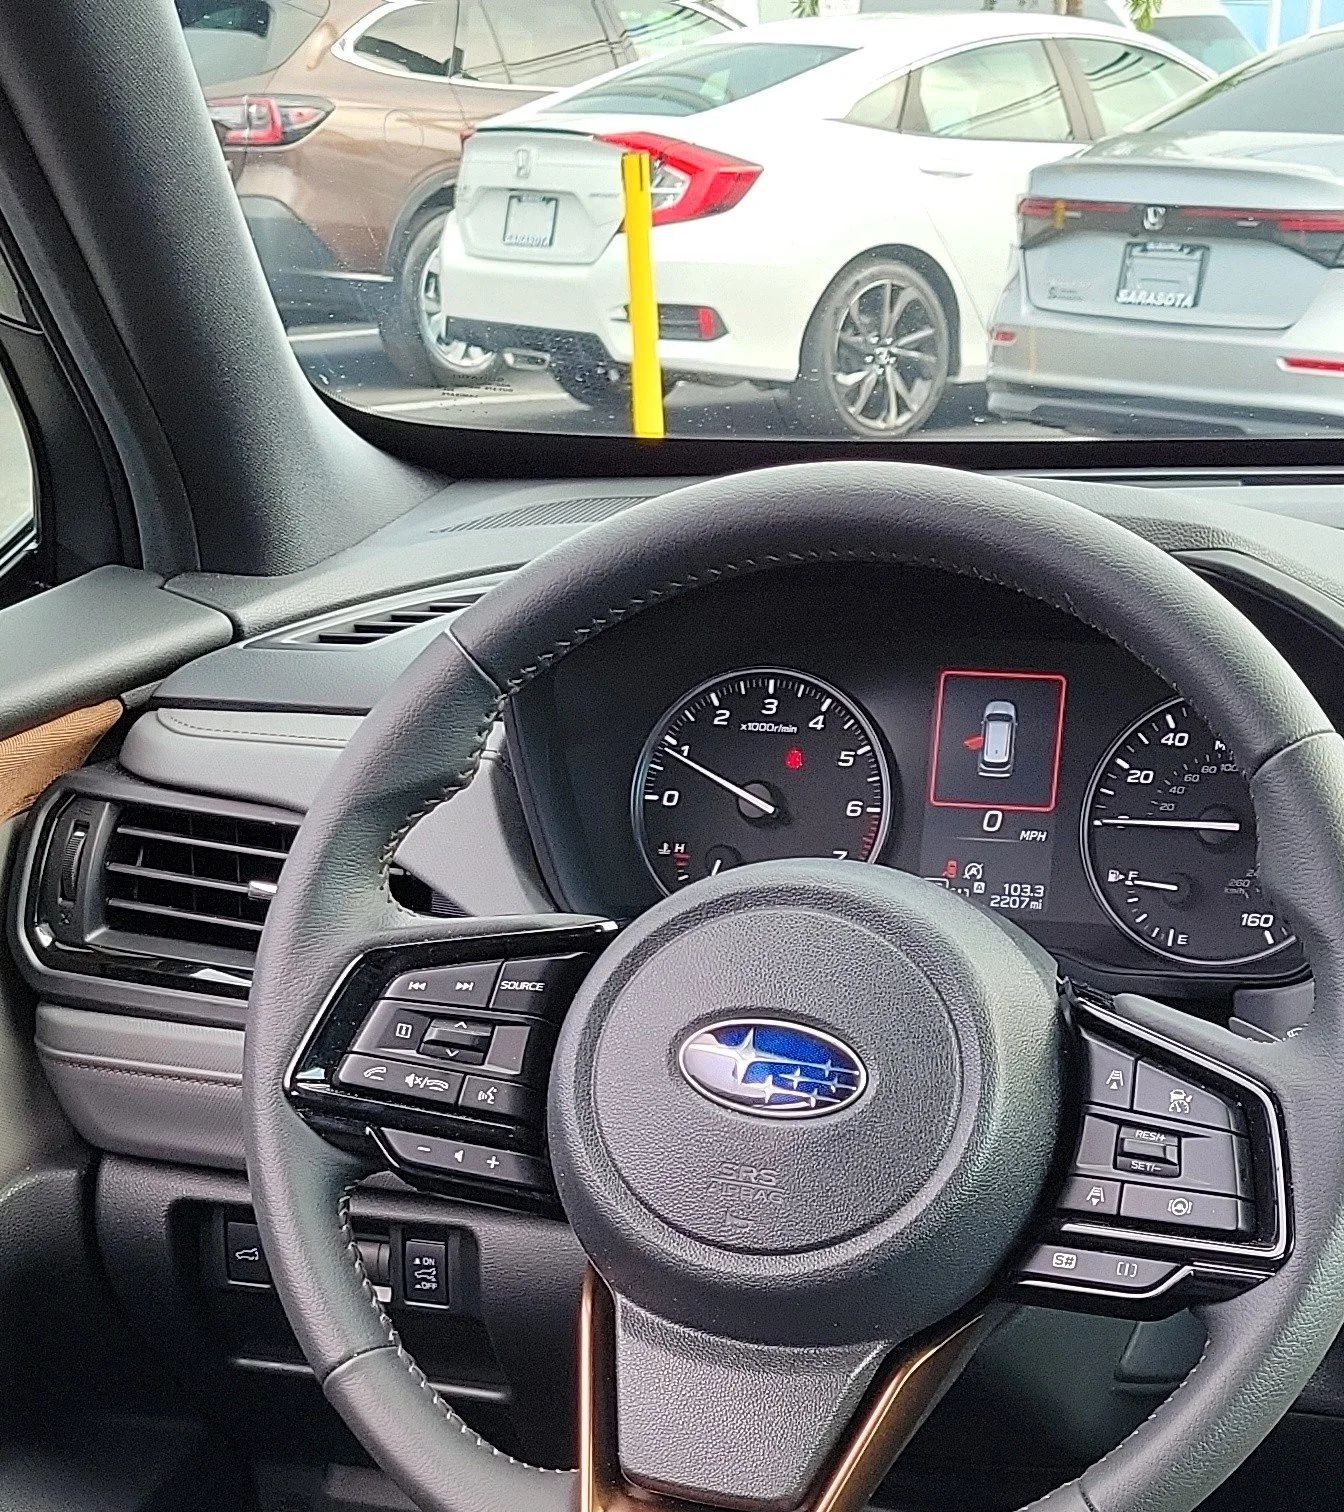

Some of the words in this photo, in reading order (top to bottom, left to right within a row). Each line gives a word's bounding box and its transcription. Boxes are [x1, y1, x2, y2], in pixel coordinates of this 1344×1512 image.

[1117, 289, 1195, 308] SARASOTA
[761, 699, 779, 715] 3
[713, 709, 731, 726] 2
[808, 715, 825, 730] 4
[1161, 733, 1189, 747] 40
[837, 751, 855, 767] 5
[1126, 770, 1154, 784] 20
[1168, 786, 1185, 795] 40
[662, 790, 679, 806] 0
[846, 801, 864, 817] 6
[1159, 802, 1175, 811] 20
[982, 810, 1003, 832] 0
[1019, 830, 1048, 842] MPH
[674, 844, 686, 853] H
[1128, 871, 1139, 880] F
[1004, 884, 1045, 897] 103.3
[1241, 913, 1274, 928] 160
[1177, 934, 1189, 945] E
[500, 980, 546, 992] SOURCE
